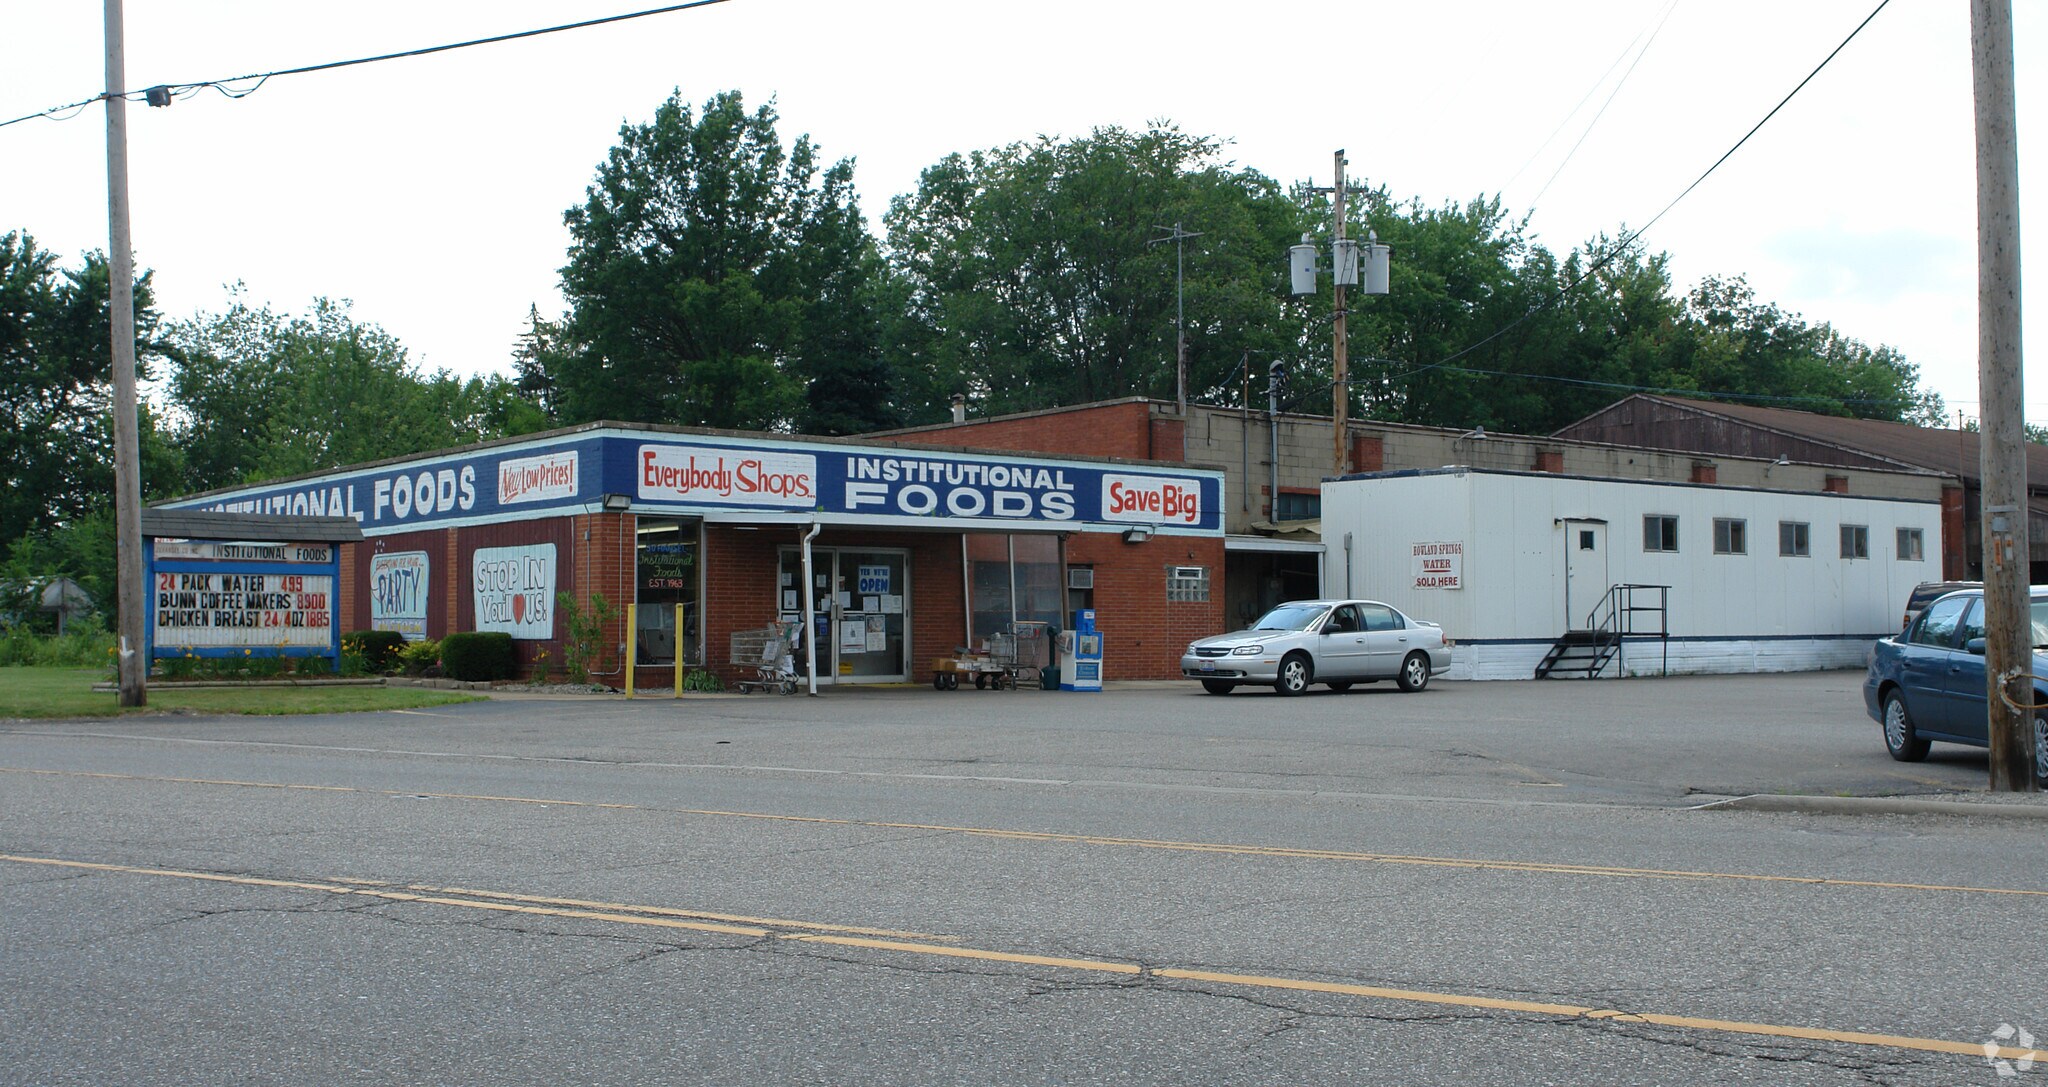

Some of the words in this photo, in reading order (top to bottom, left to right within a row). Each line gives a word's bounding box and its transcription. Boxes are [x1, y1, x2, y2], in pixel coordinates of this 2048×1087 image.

[500, 466, 521, 500] New
[521, 466, 539, 494] Low
[539, 459, 574, 493] Prices!
[643, 451, 731, 497] Everybody
[847, 457, 1075, 491] INSTITUTIONAL
[374, 464, 476, 520] FOODS
[845, 481, 1076, 520] FOODS
[1110, 481, 1160, 514] Save
[1163, 484, 1197, 523] Big
[212, 544, 287, 560] INSTITUTIONAL
[296, 547, 327, 561] FOODS
[1438, 543, 1462, 555] SPRINGS
[653, 565, 683, 577] Foods
[1423, 559, 1451, 569] WATER
[160, 573, 175, 590] 24
[182, 574, 211, 590] PACK
[222, 575, 264, 591] WATER
[281, 576, 303, 592] 499
[477, 560, 519, 592] STOP
[523, 556, 546, 590] IN
[667, 579, 684, 588] 1963
[1416, 577, 1437, 587] SOLD
[1438, 576, 1458, 587] HERE
[378, 567, 421, 615] PARTY
[860, 578, 888, 592] OPEN
[160, 593, 196, 608] BUNN
[201, 593, 243, 609] COFFEE
[246, 594, 291, 610] MAKERS
[297, 594, 326, 610] 8900
[482, 591, 512, 624] You'll
[524, 589, 547, 625] US!
[159, 610, 209, 627] CHICKEN
[214, 610, 260, 627] BREAST
